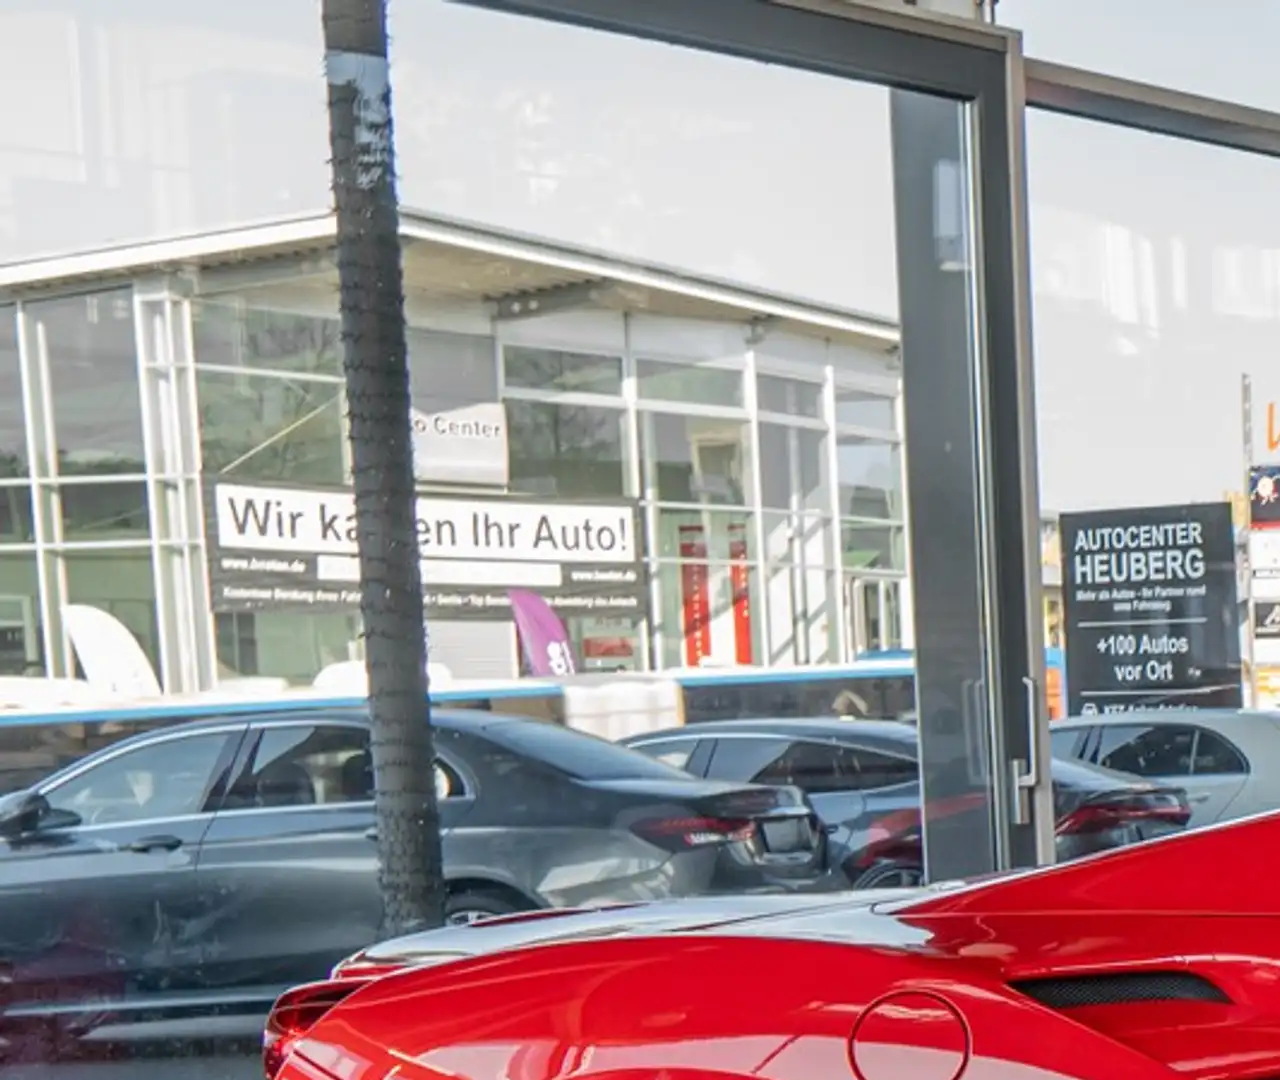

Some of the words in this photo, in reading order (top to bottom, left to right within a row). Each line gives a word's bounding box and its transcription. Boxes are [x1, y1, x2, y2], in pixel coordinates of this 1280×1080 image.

[434, 416, 500, 438] Center
[228, 497, 304, 539] Wir
[473, 512, 522, 549] Ihr
[533, 515, 627, 551] Auto!
[1074, 522, 1203, 551] AUTOCENTER
[1074, 547, 1206, 585] HEUBERG
[1096, 634, 1136, 656] +100
[1139, 633, 1189, 655] Autos
[1114, 664, 1143, 681] vor
[1145, 659, 1174, 681] Ort
